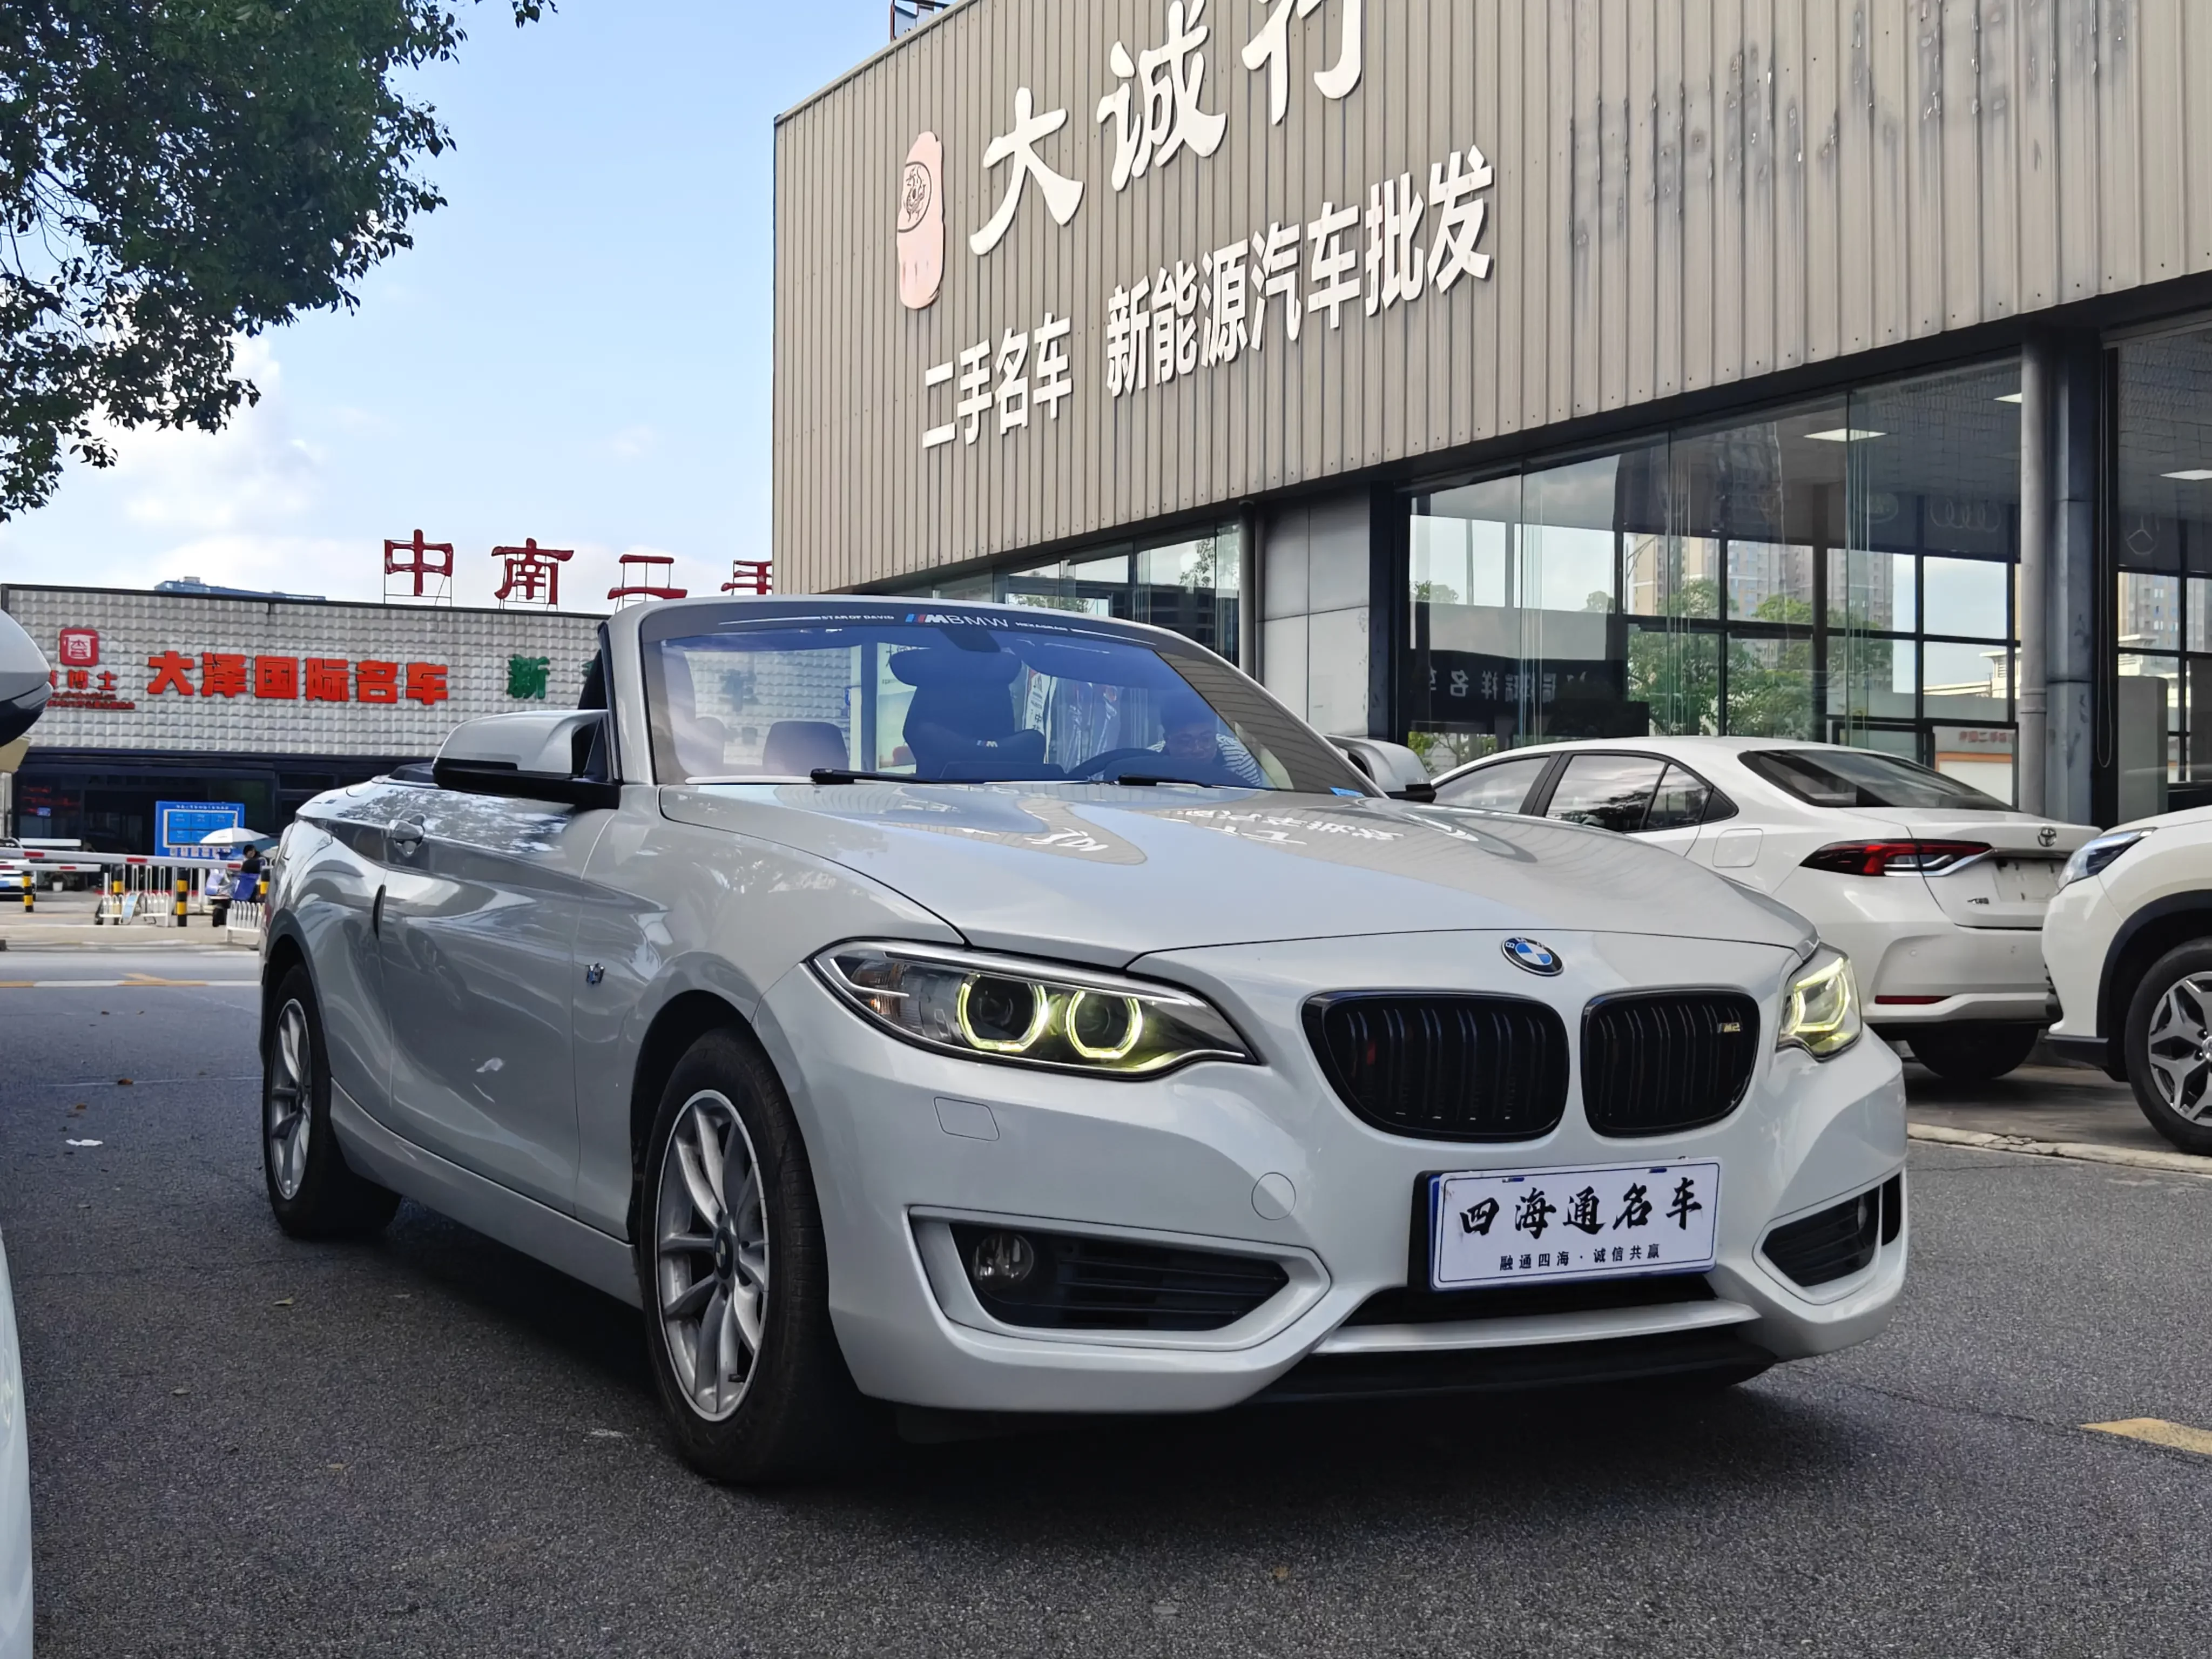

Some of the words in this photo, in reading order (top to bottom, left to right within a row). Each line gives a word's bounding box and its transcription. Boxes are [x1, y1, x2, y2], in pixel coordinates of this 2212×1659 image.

[922, 313, 1073, 449] 二手名车
[1106, 145, 1493, 397] 新能源汽车批发
[946, 615, 1009, 628] BMW
[147, 650, 449, 705] 大泽国际名车
[1459, 1177, 1703, 1240] 四海通名车
